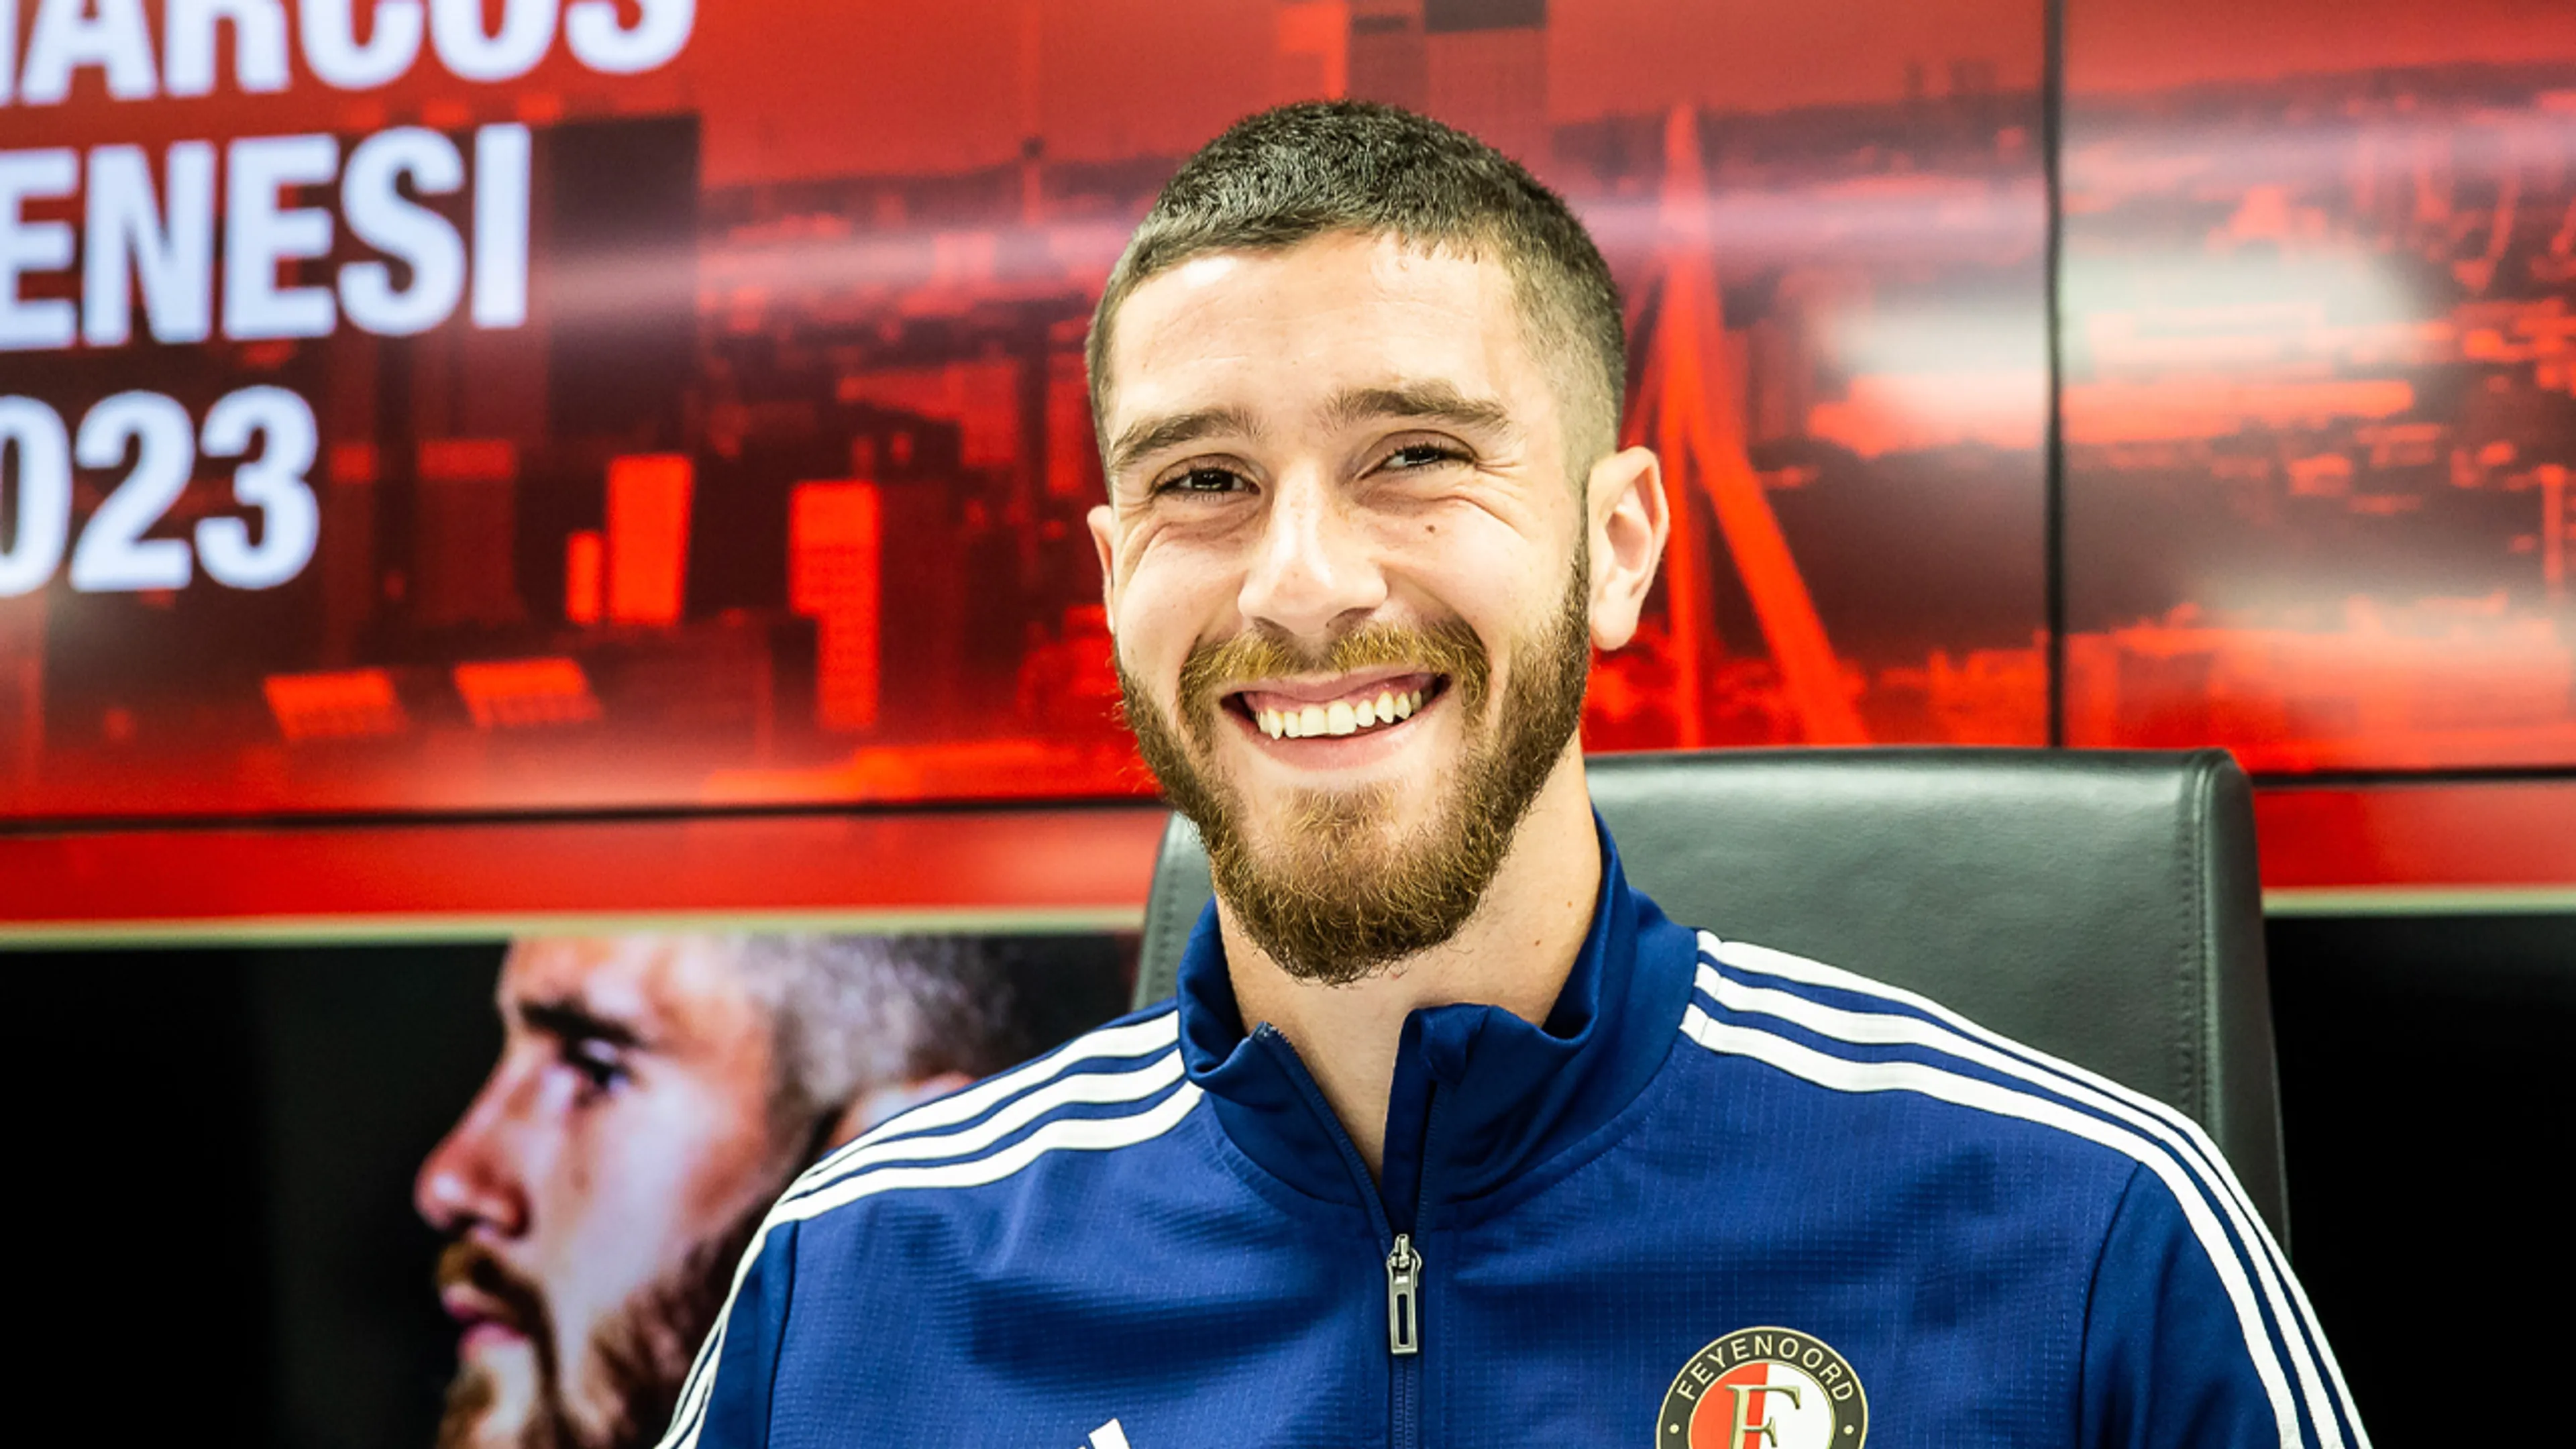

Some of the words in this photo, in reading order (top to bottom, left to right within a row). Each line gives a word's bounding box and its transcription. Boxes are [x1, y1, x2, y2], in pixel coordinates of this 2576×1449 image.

[0, 123, 531, 350] ENESI
[1677, 1334, 1854, 1401] FEYENOORD
[1725, 1385, 1801, 1449] F
